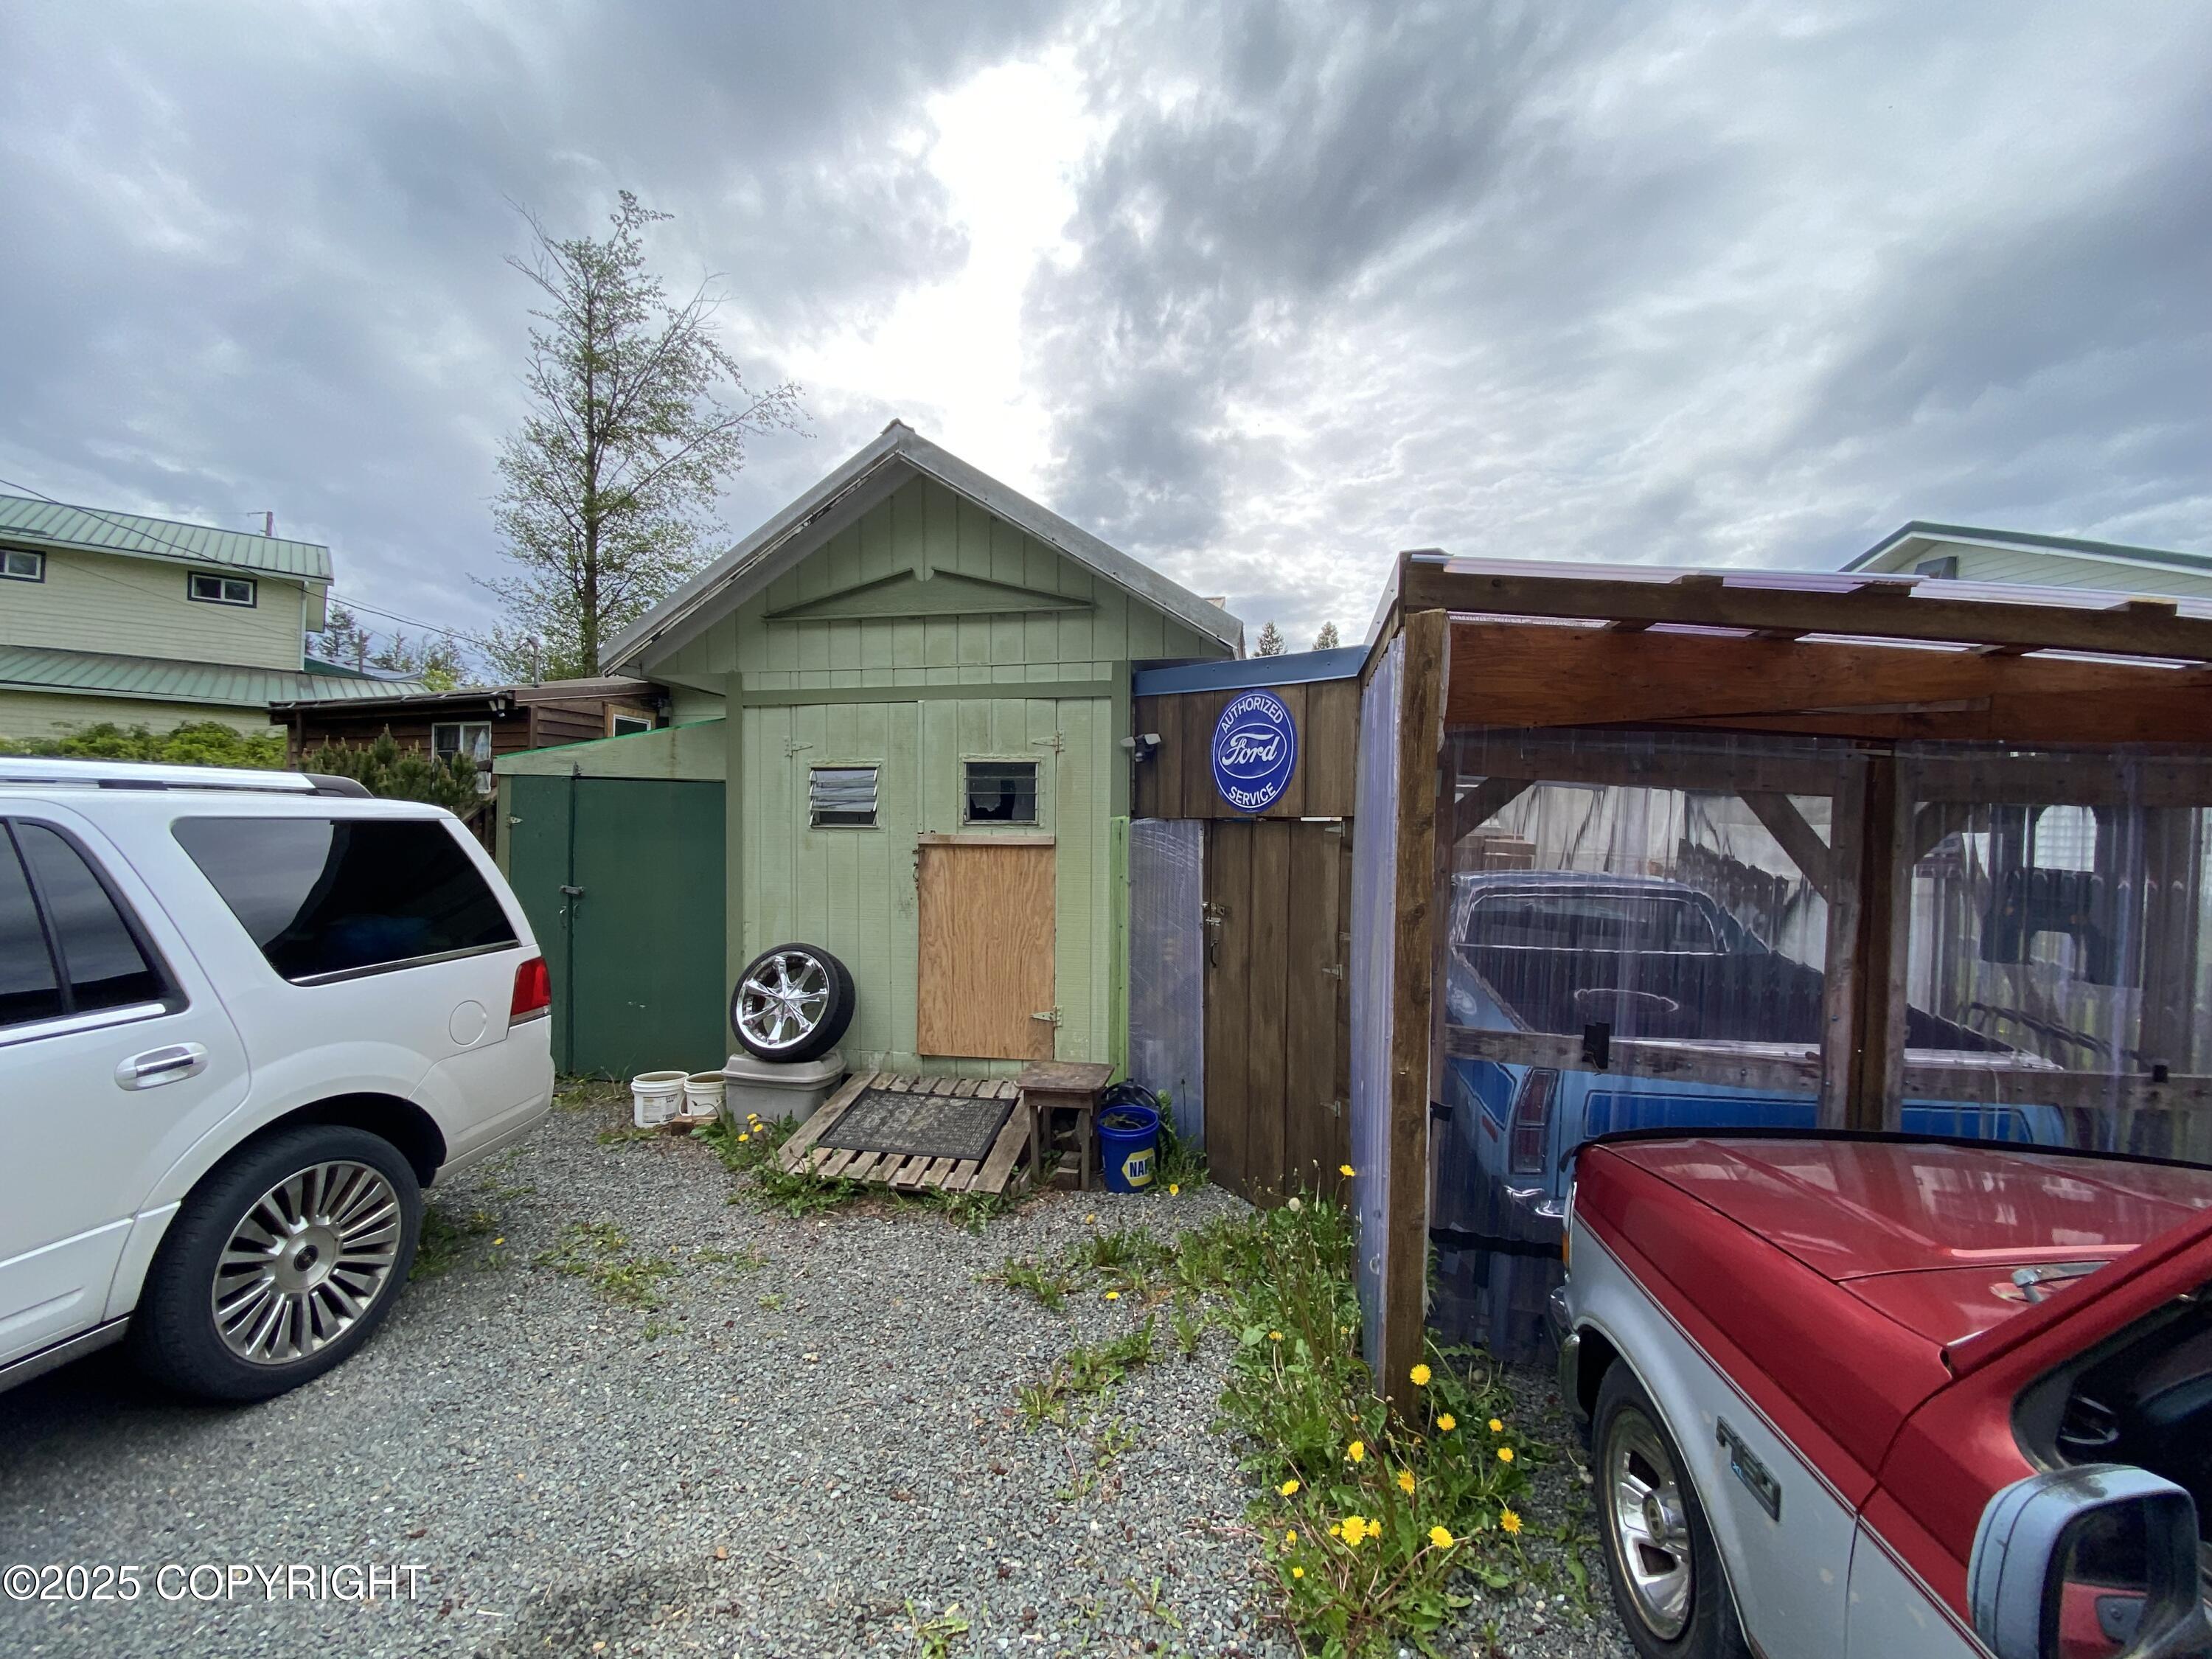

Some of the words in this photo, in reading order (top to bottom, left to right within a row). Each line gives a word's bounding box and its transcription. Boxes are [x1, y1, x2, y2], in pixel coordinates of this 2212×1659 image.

[1221, 697, 1284, 734] AUTHORIZED
[1222, 733, 1281, 766] Ford
[1228, 782, 1276, 806] SERVICE
